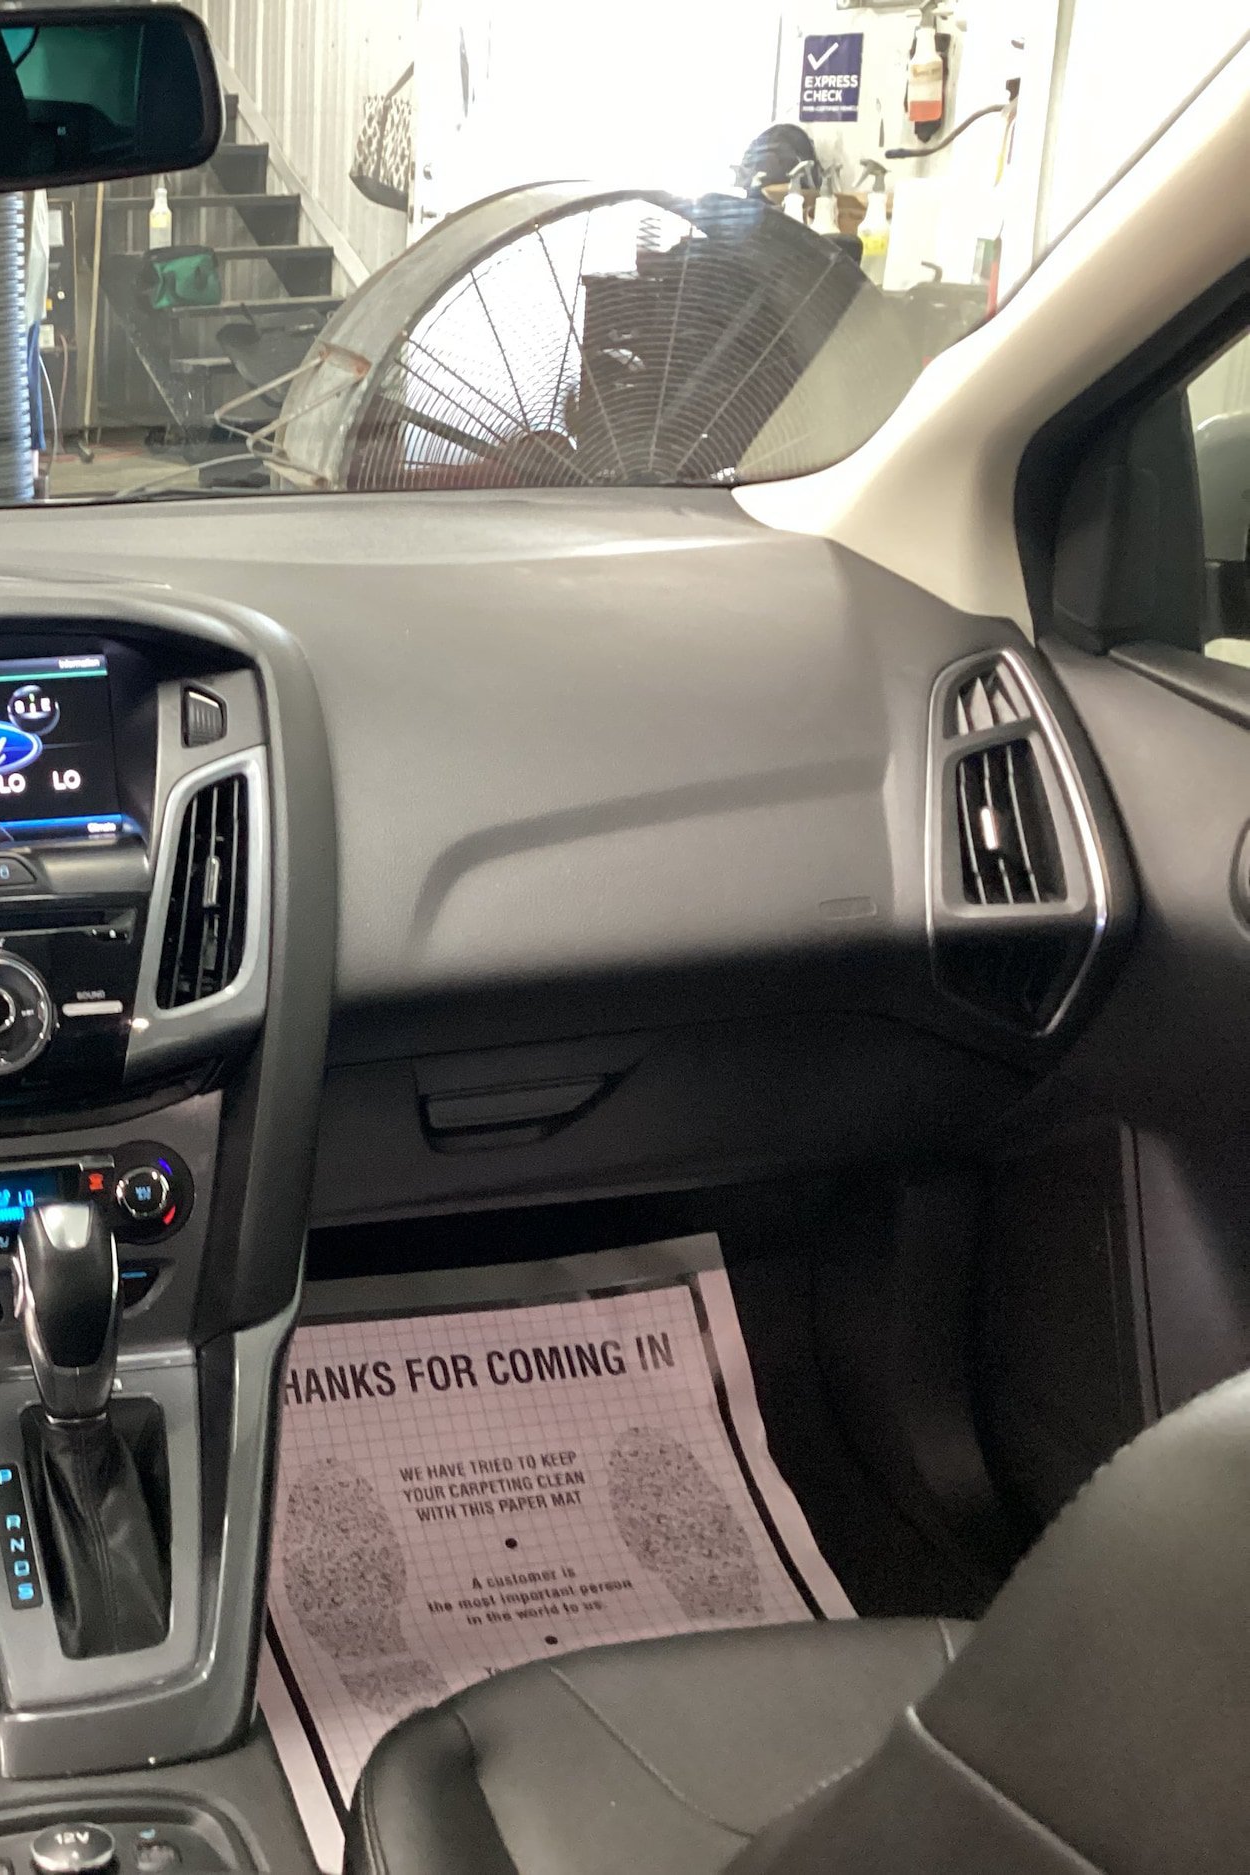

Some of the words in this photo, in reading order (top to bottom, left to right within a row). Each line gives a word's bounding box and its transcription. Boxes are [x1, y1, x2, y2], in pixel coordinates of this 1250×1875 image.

[804, 75, 858, 88] EXPRESS
[803, 89, 843, 102] CHECK
[52, 769, 81, 791] LO
[284, 1361, 397, 1404] HANKS
[405, 1354, 478, 1393] FOR
[486, 1339, 627, 1386] COMING
[636, 1332, 675, 1371] IN
[400, 1467, 425, 1482] WE
[427, 1461, 466, 1479] HAVE
[469, 1457, 513, 1475] TRIED
[518, 1455, 536, 1470] TO
[540, 1451, 577, 1467] KEEP
[403, 1485, 446, 1503] YOUR
[449, 1476, 533, 1499] CARPETING
[537, 1471, 586, 1489] CLEAN
[415, 1503, 457, 1522] WITH
[460, 1501, 495, 1517] THIS
[499, 1494, 547, 1513] PAPER
[551, 1490, 582, 1507] MAT
[5, 1514, 21, 1531] R
[10, 1536, 25, 1553] N
[14, 1560, 30, 1576] D
[472, 1577, 482, 1590] A
[487, 1570, 557, 1588] customer
[562, 1566, 576, 1579] is
[17, 1583, 34, 1600] S
[427, 1602, 453, 1615] the
[458, 1595, 496, 1610] most
[501, 1585, 575, 1605] important
[579, 1579, 633, 1597] person
[466, 1613, 483, 1626] in
[486, 1611, 512, 1624] the
[517, 1604, 560, 1620] world
[562, 1602, 579, 1614] to
[55, 1831, 90, 1845] 12V
